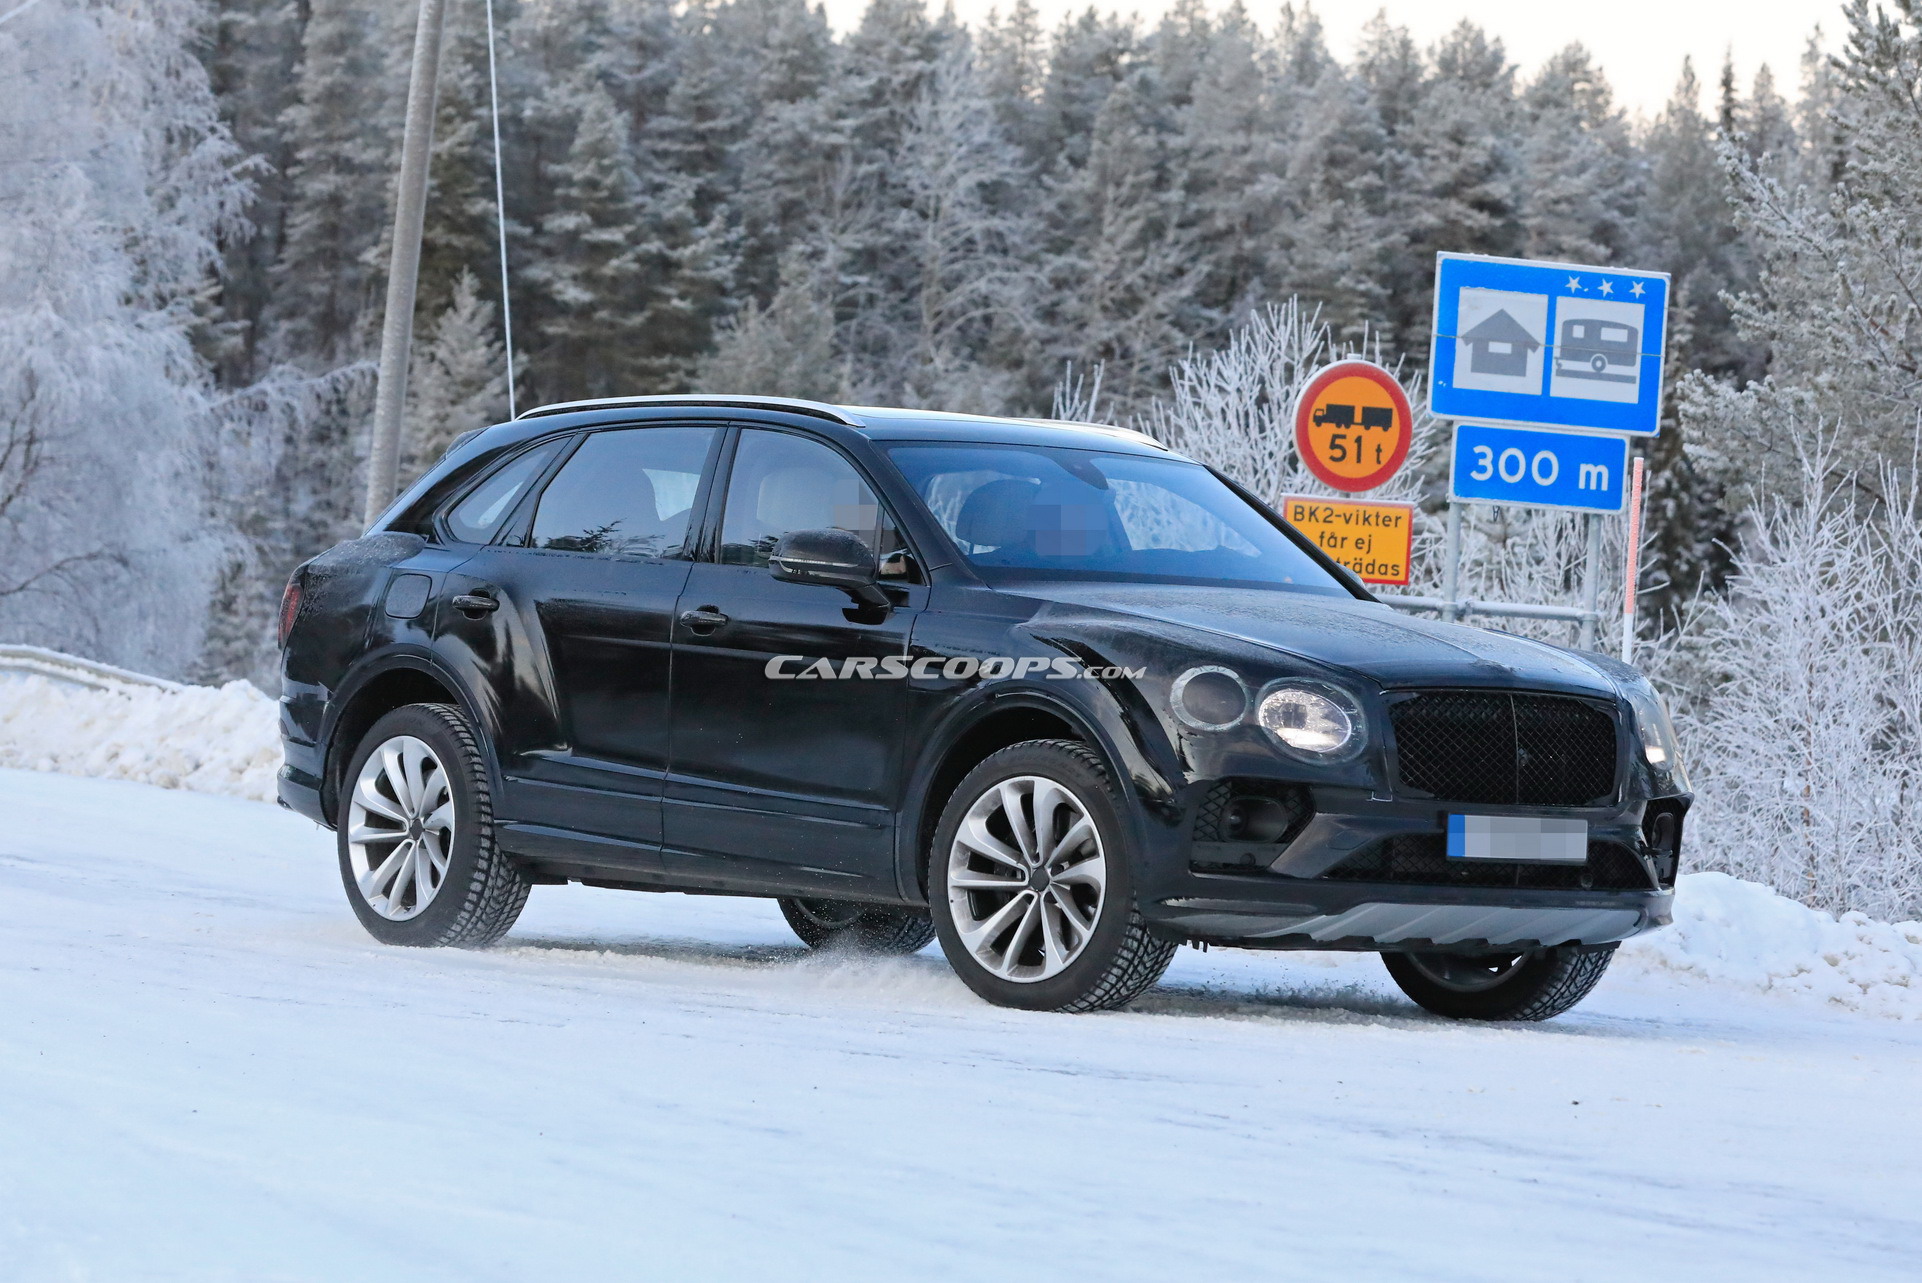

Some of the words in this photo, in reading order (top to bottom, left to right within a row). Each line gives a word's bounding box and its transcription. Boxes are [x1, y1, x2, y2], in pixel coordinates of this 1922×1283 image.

[1329, 434, 1362, 464] 51
[1375, 443, 1383, 465] t
[1470, 445, 1559, 486] 300
[1578, 463, 1609, 491] m
[1293, 504, 1402, 528] BK2-vikter
[1319, 531, 1348, 549] får
[1354, 534, 1372, 554] ej
